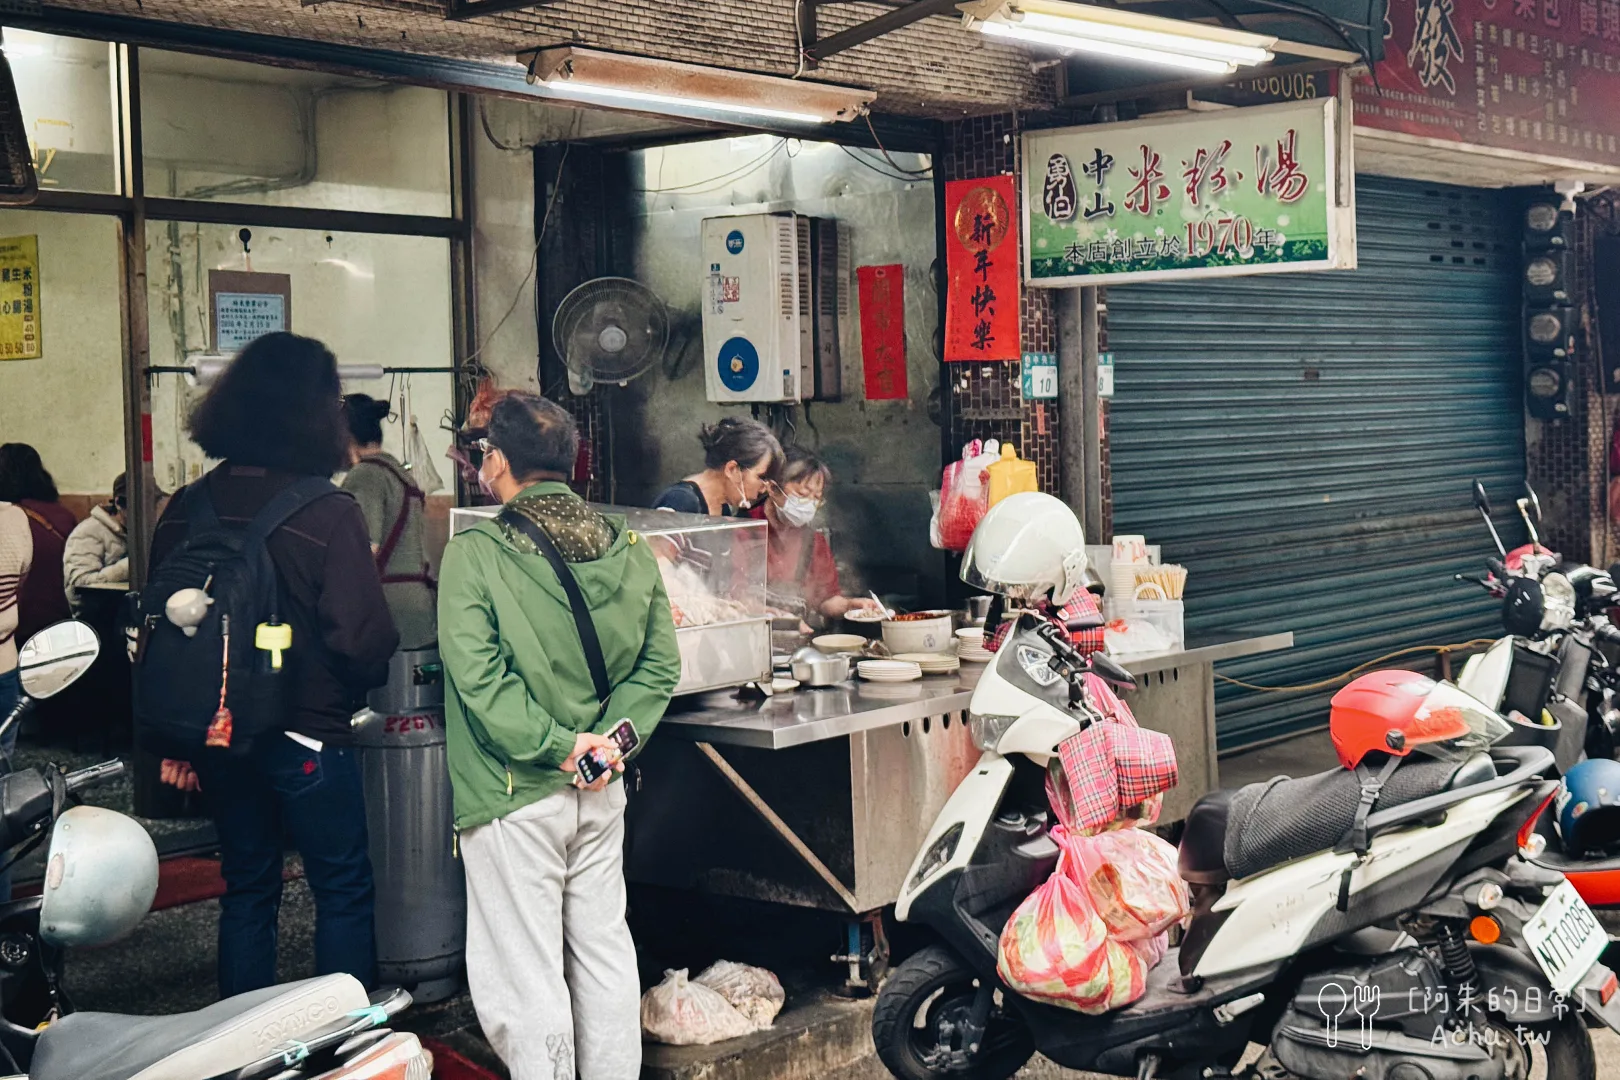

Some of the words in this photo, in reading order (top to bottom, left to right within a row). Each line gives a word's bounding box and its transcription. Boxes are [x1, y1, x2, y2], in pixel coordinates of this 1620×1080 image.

[1082, 148, 1114, 219] 中山
[1124, 129, 1308, 214] 米粉湯
[968, 213, 996, 351] 新年快樂
[1040, 377, 1052, 394] 10
[1535, 897, 1595, 978] NTT-0285
